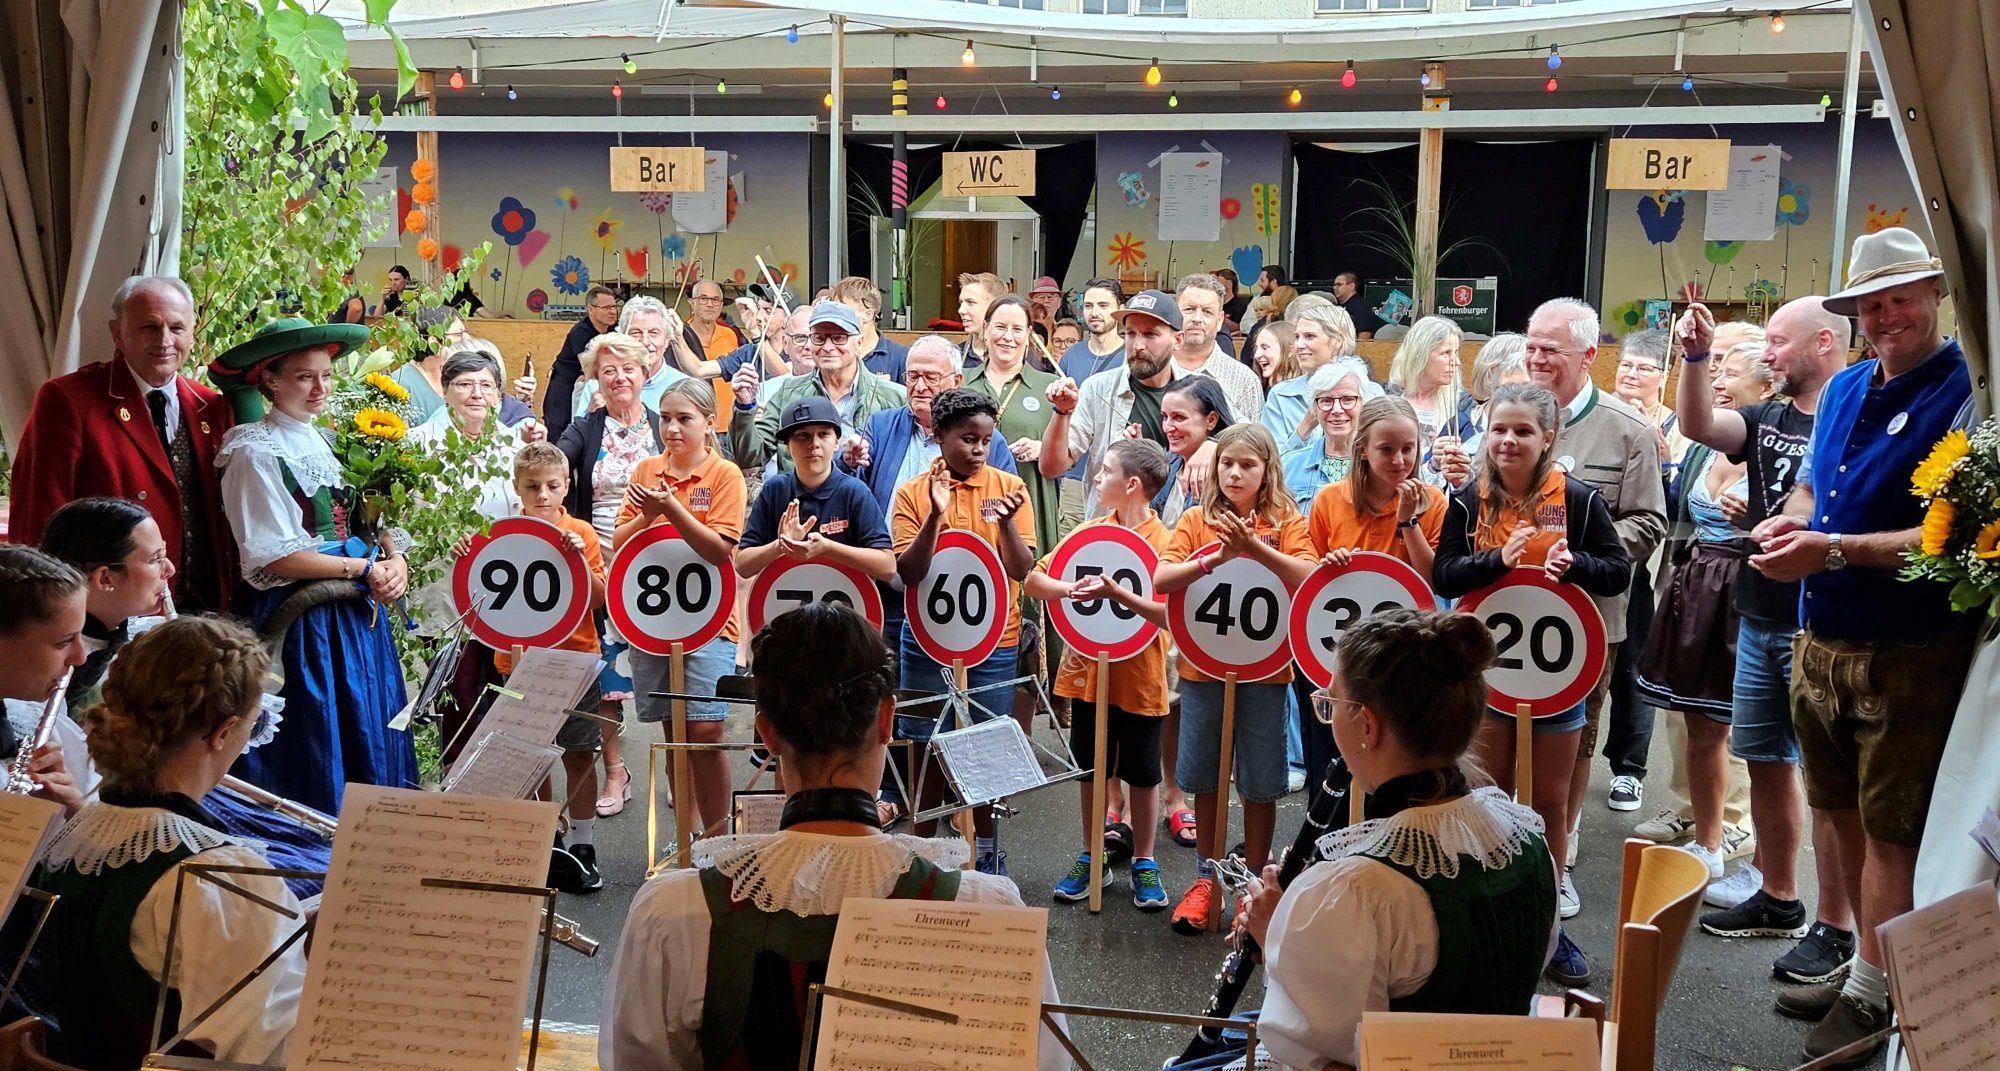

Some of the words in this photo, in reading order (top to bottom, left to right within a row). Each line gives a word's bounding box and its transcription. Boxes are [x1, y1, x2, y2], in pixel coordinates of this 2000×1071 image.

[640, 156, 676, 183] Bar
[969, 155, 1003, 183] WC
[1645, 149, 1692, 179] Bar
[690, 487, 711, 498] JUNG
[1538, 504, 1566, 517] JUNG
[480, 559, 561, 612] 90
[636, 563, 712, 616] 80
[927, 573, 987, 627] 60
[1194, 583, 1280, 641] 40
[1320, 597, 1405, 652] 3
[1485, 612, 1574, 673] 20
[915, 913, 971, 928] Ehrenwert
[1449, 1047, 1505, 1059] Ehrenwert
